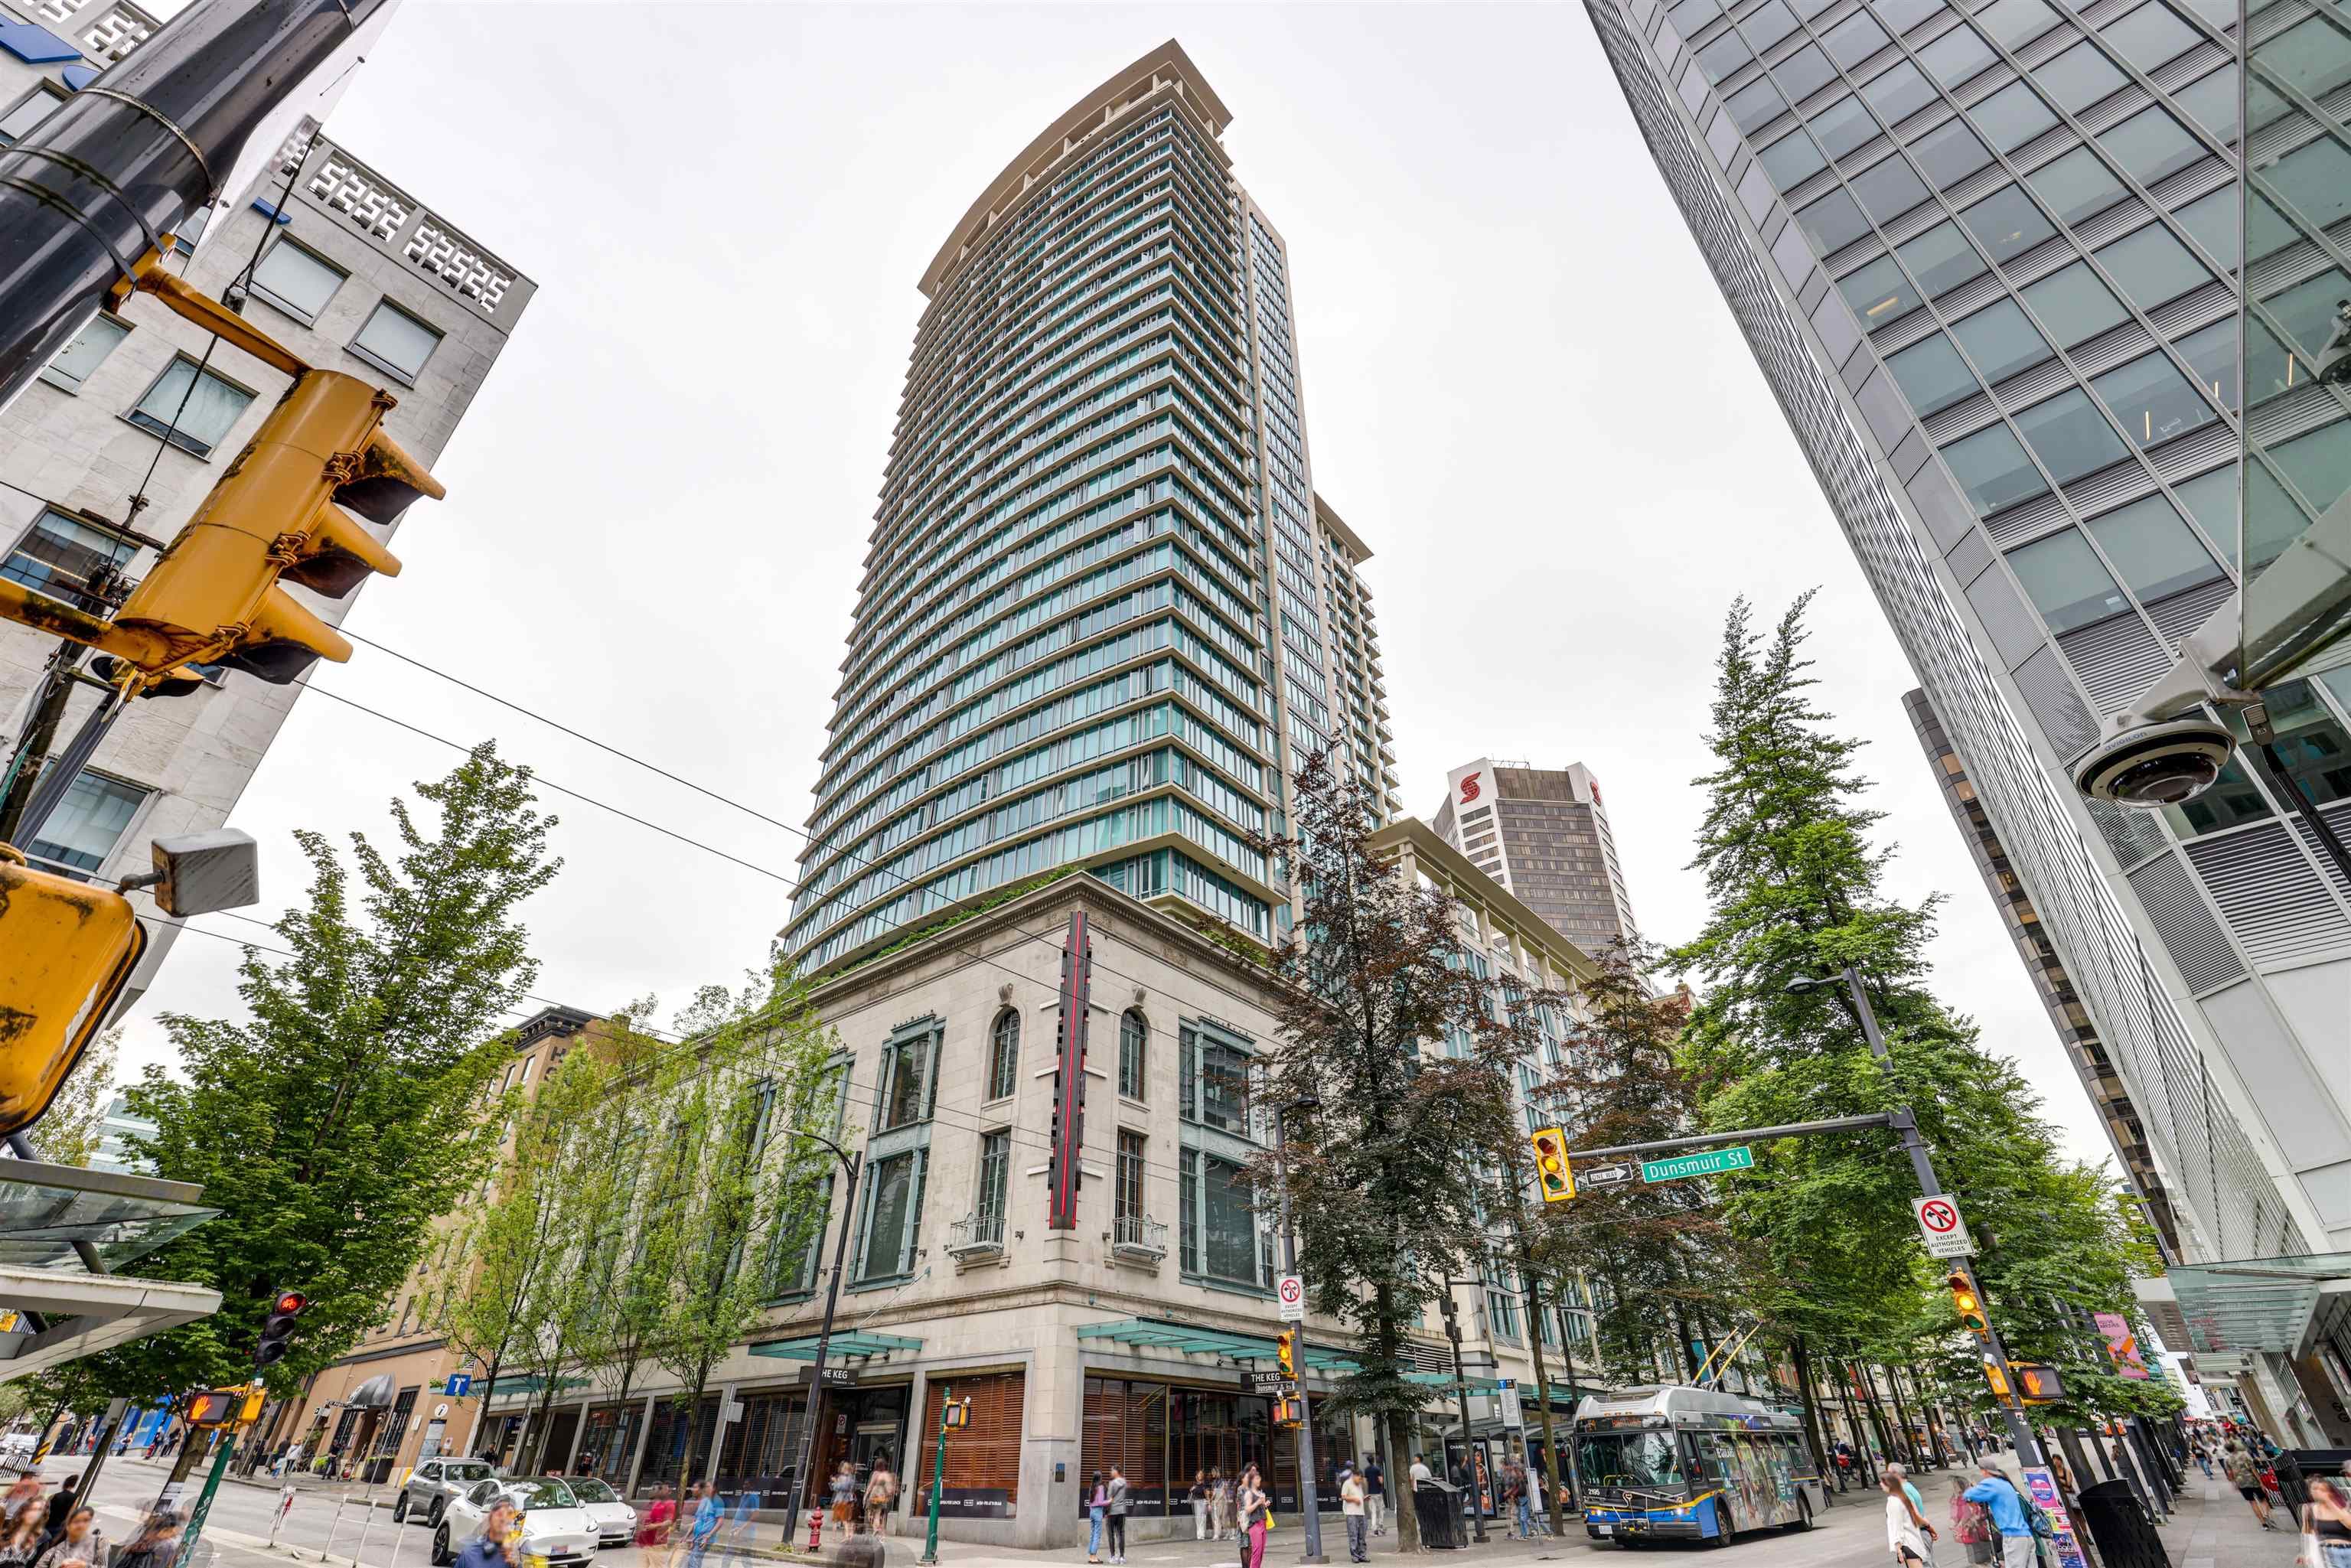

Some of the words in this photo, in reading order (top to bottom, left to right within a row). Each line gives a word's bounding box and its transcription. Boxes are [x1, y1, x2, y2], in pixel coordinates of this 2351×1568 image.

[1649, 1156, 1721, 1178] Dunsmuir
[1730, 1151, 1746, 1166] St
[1592, 1172, 1605, 1182] ONE
[1931, 1239, 1968, 1248] AUTHORIZED
[833, 1370, 849, 1379] KEG
[1250, 1374, 1265, 1383] THE
[1266, 1372, 1280, 1381] KEG
